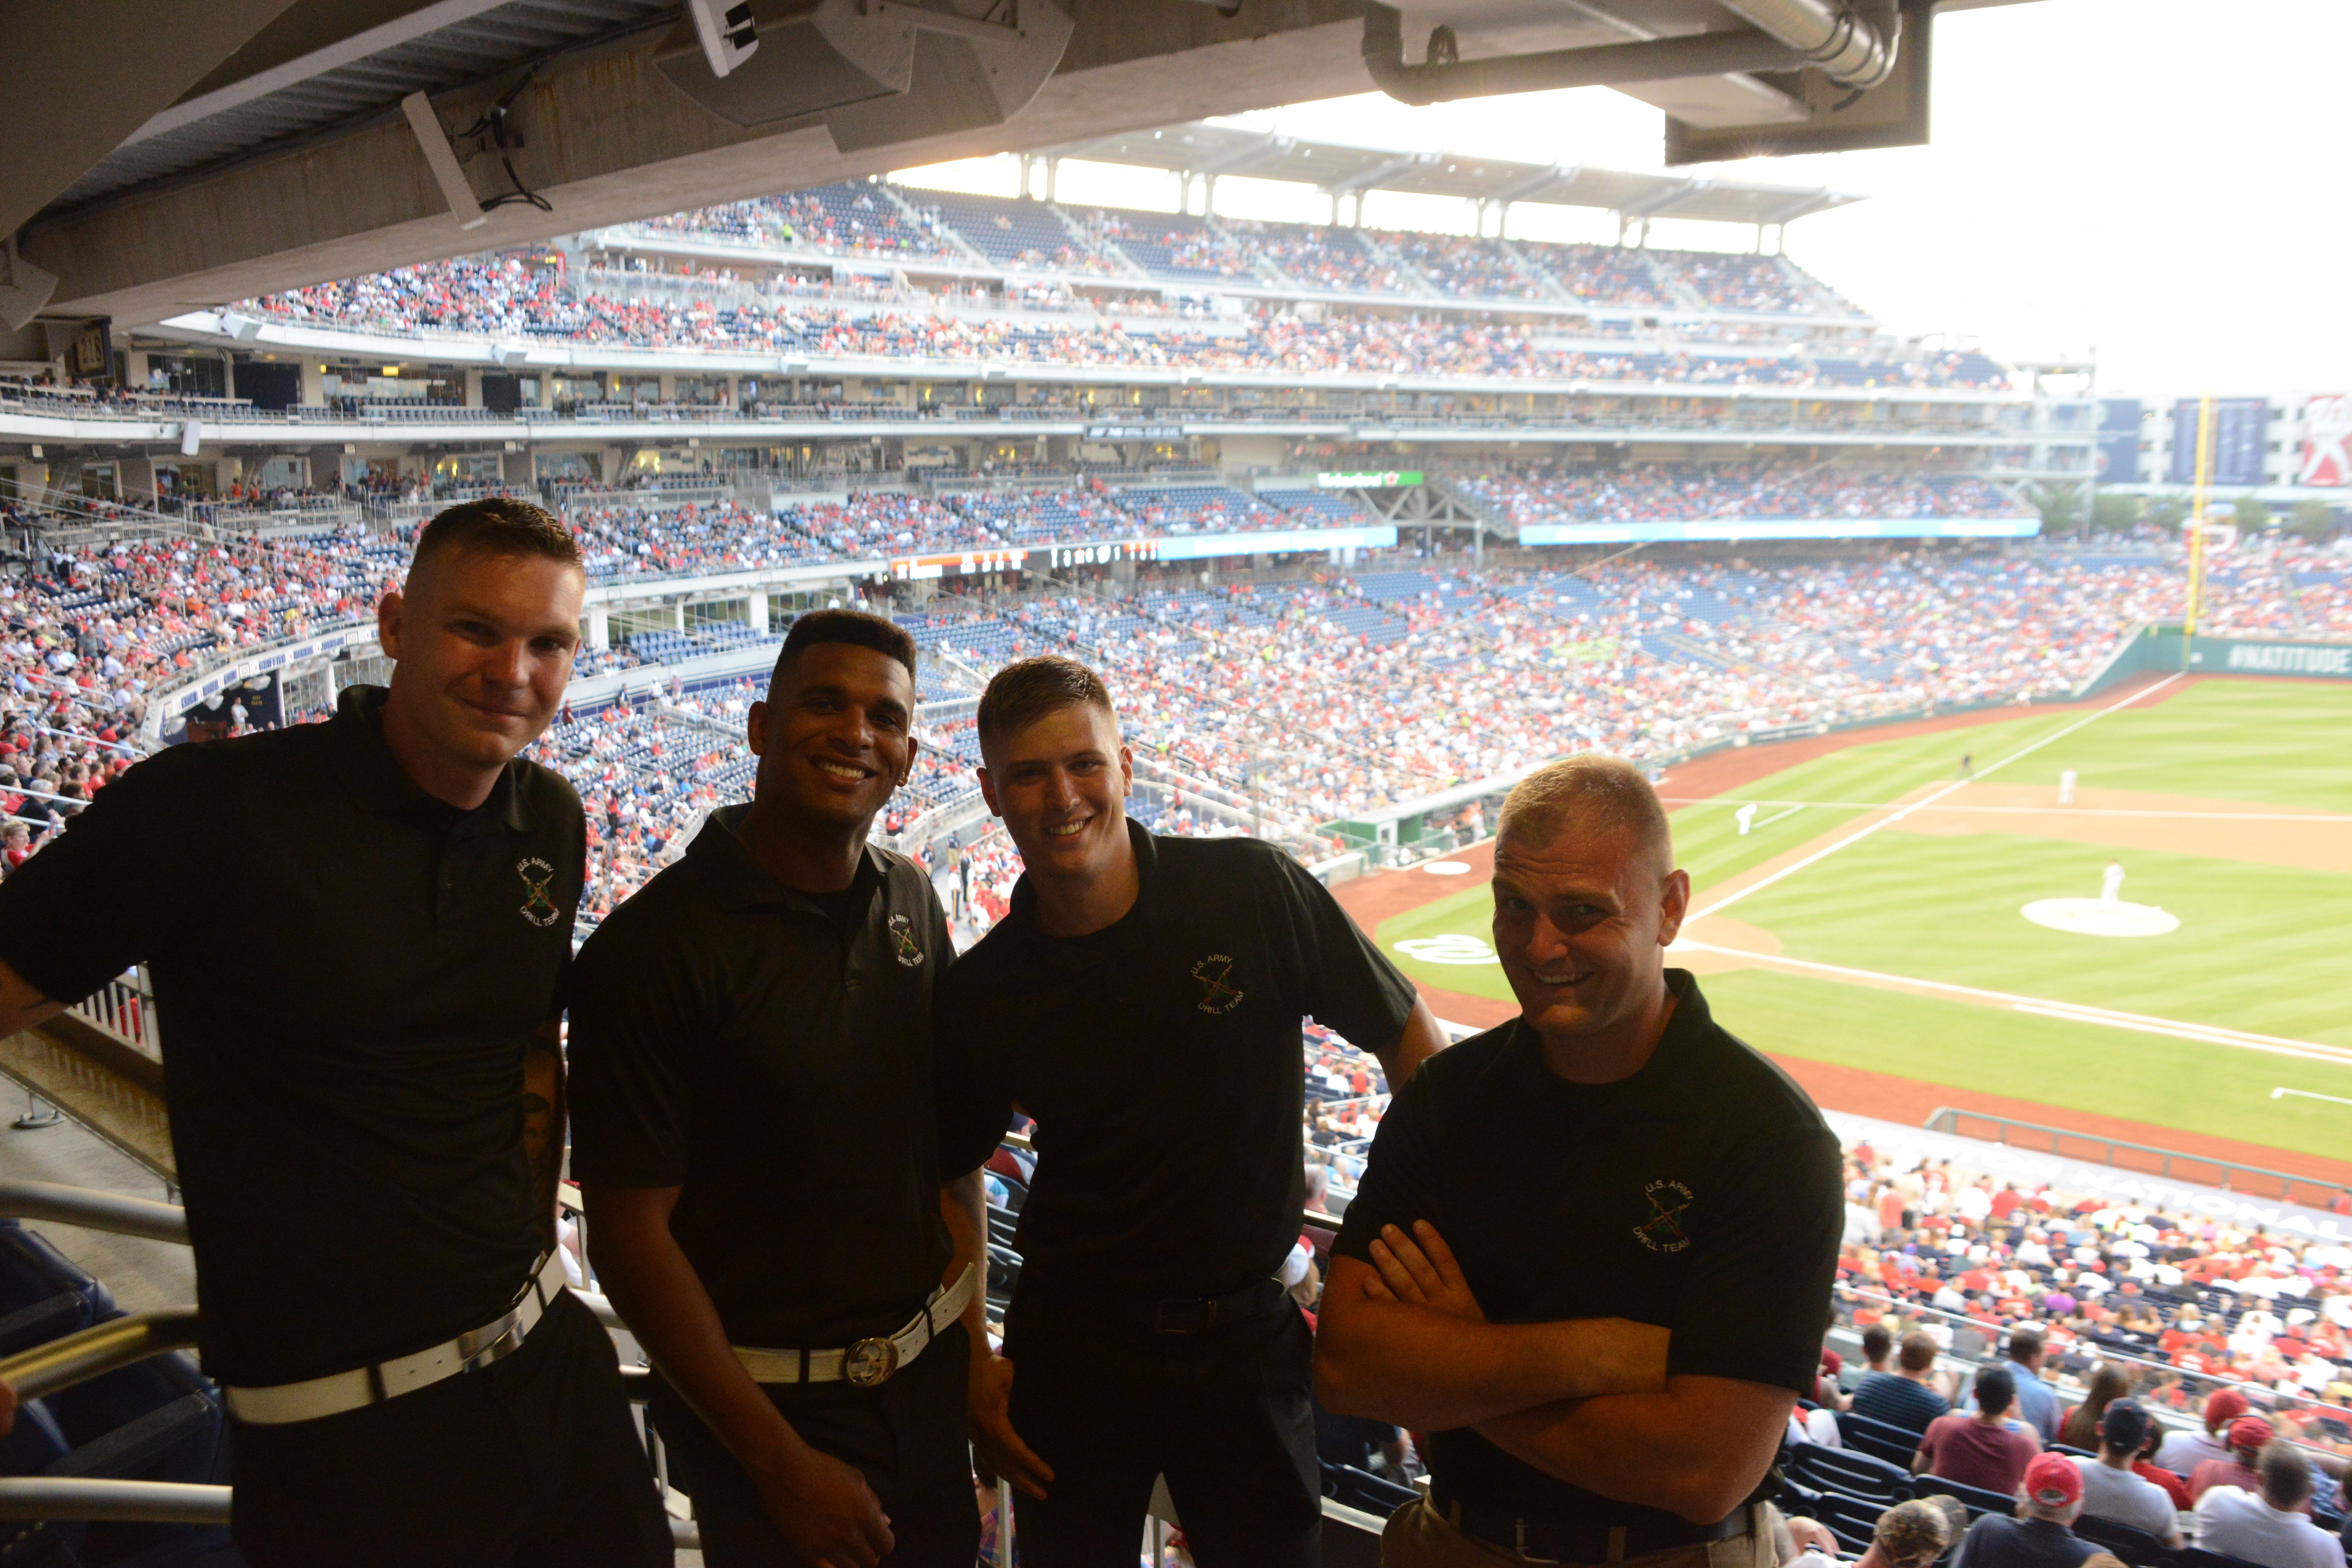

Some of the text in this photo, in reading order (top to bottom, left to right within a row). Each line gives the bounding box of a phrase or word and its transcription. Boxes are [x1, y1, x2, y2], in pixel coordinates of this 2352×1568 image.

[2227, 644, 2352, 673] #NATITUDE
[516, 856, 554, 873] U.S. ARMY
[520, 905, 560, 926] DRILL TEAM
[888, 914, 910, 927] U.S. ARMY
[898, 951, 925, 966] DRILL TEAM
[1190, 954, 1233, 974] U.S. ARMY
[1197, 991, 1244, 1014] DRILL TEAM
[1825, 1116, 2063, 1180] SHINGTON
[1645, 1180, 1694, 1199] U.S. ARMY
[1632, 1226, 1691, 1252] DRILL TEAM
